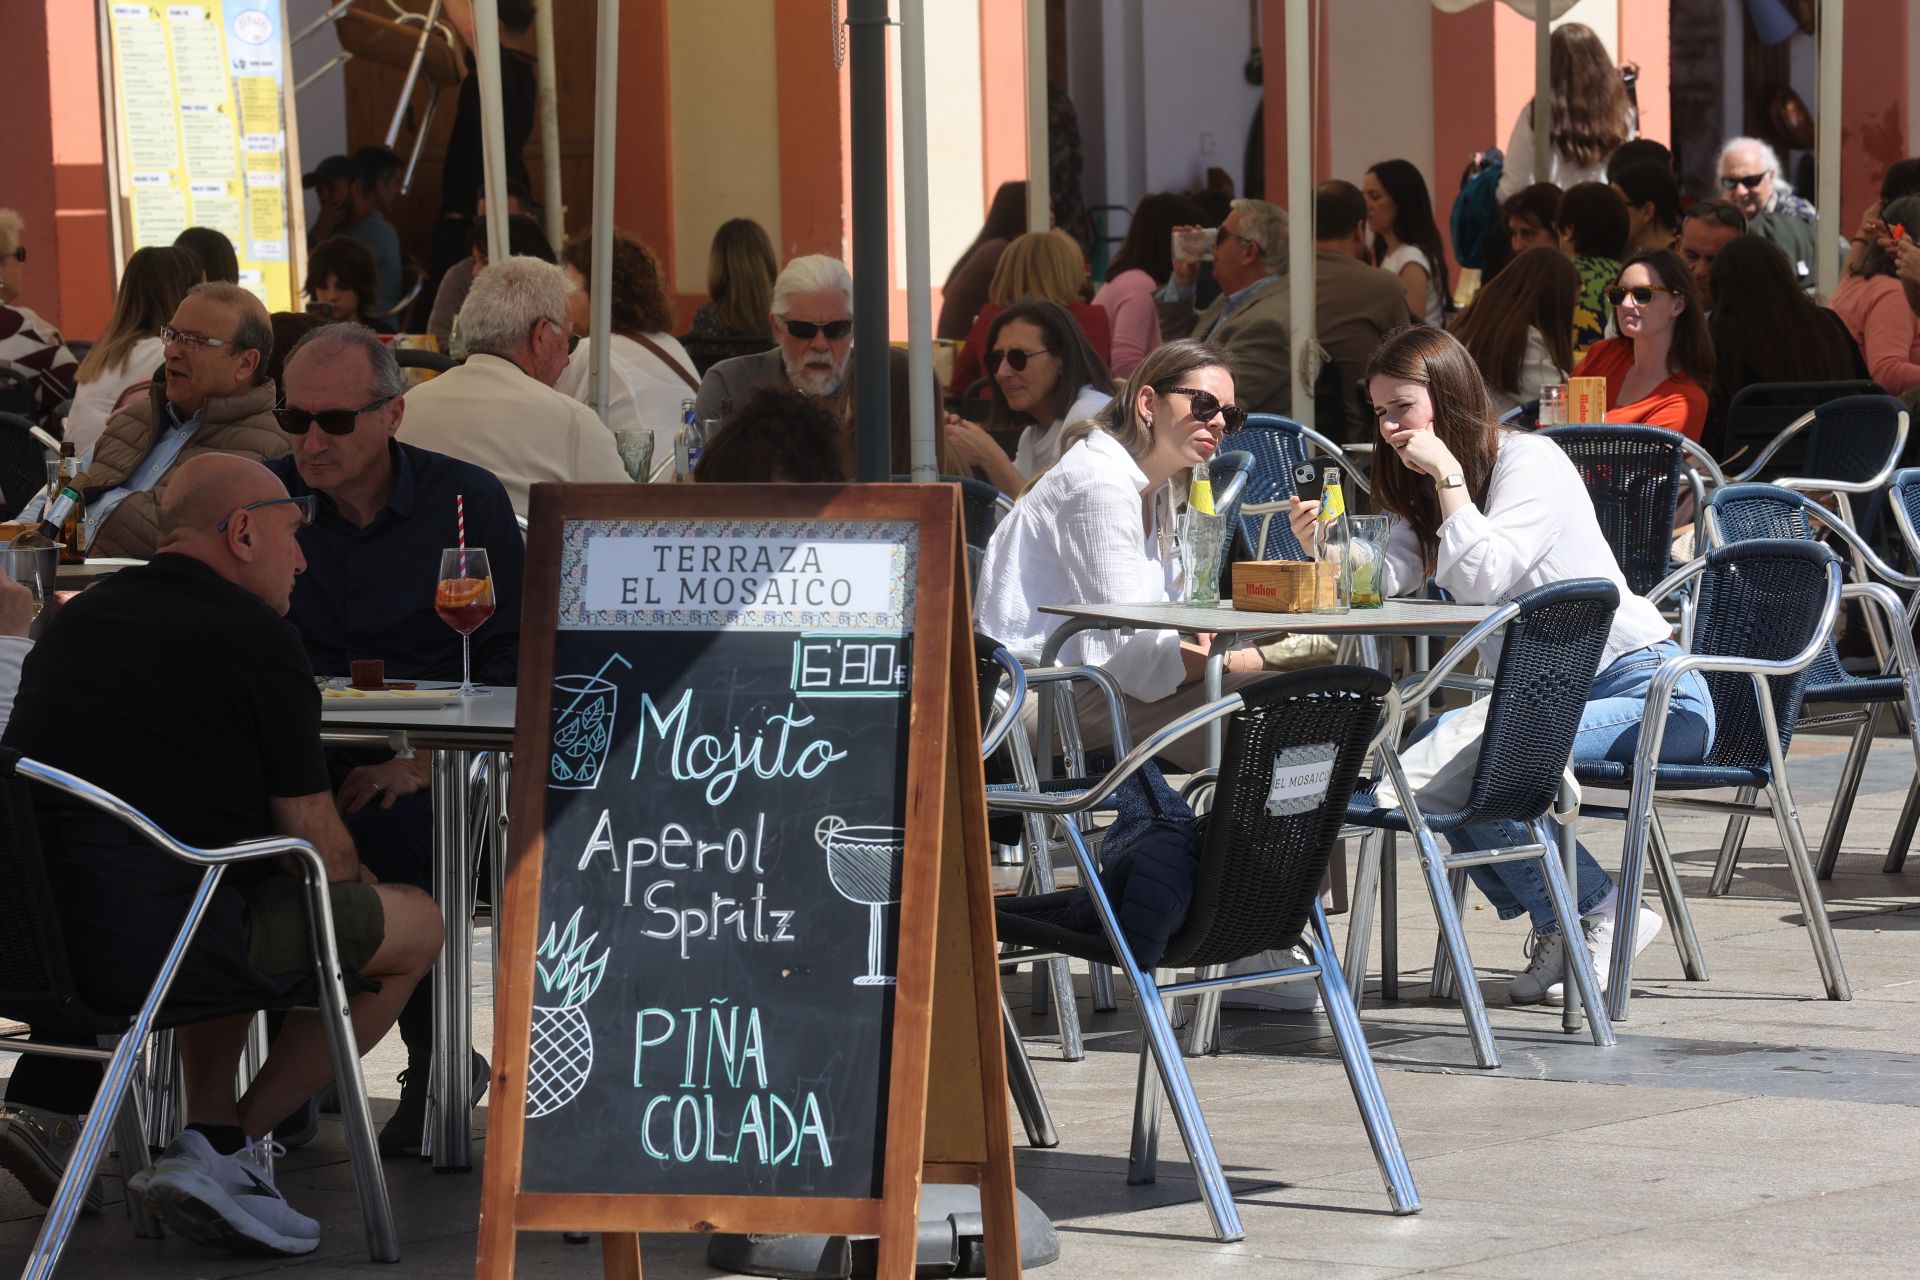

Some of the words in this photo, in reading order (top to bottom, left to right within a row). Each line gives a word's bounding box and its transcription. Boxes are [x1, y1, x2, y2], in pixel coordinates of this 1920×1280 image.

[620, 578, 661, 604] EL
[679, 577, 852, 607] MOSAICO
[653, 546, 822, 573] TERRAZA
[631, 687, 848, 806] Mojito
[1275, 778, 1285, 789] EL
[1288, 771, 1329, 787] MOSAICO
[578, 808, 767, 907] Aperol
[639, 880, 796, 959] Spritz
[633, 997, 769, 1090] PIÑA
[640, 1091, 833, 1168] COLADA
